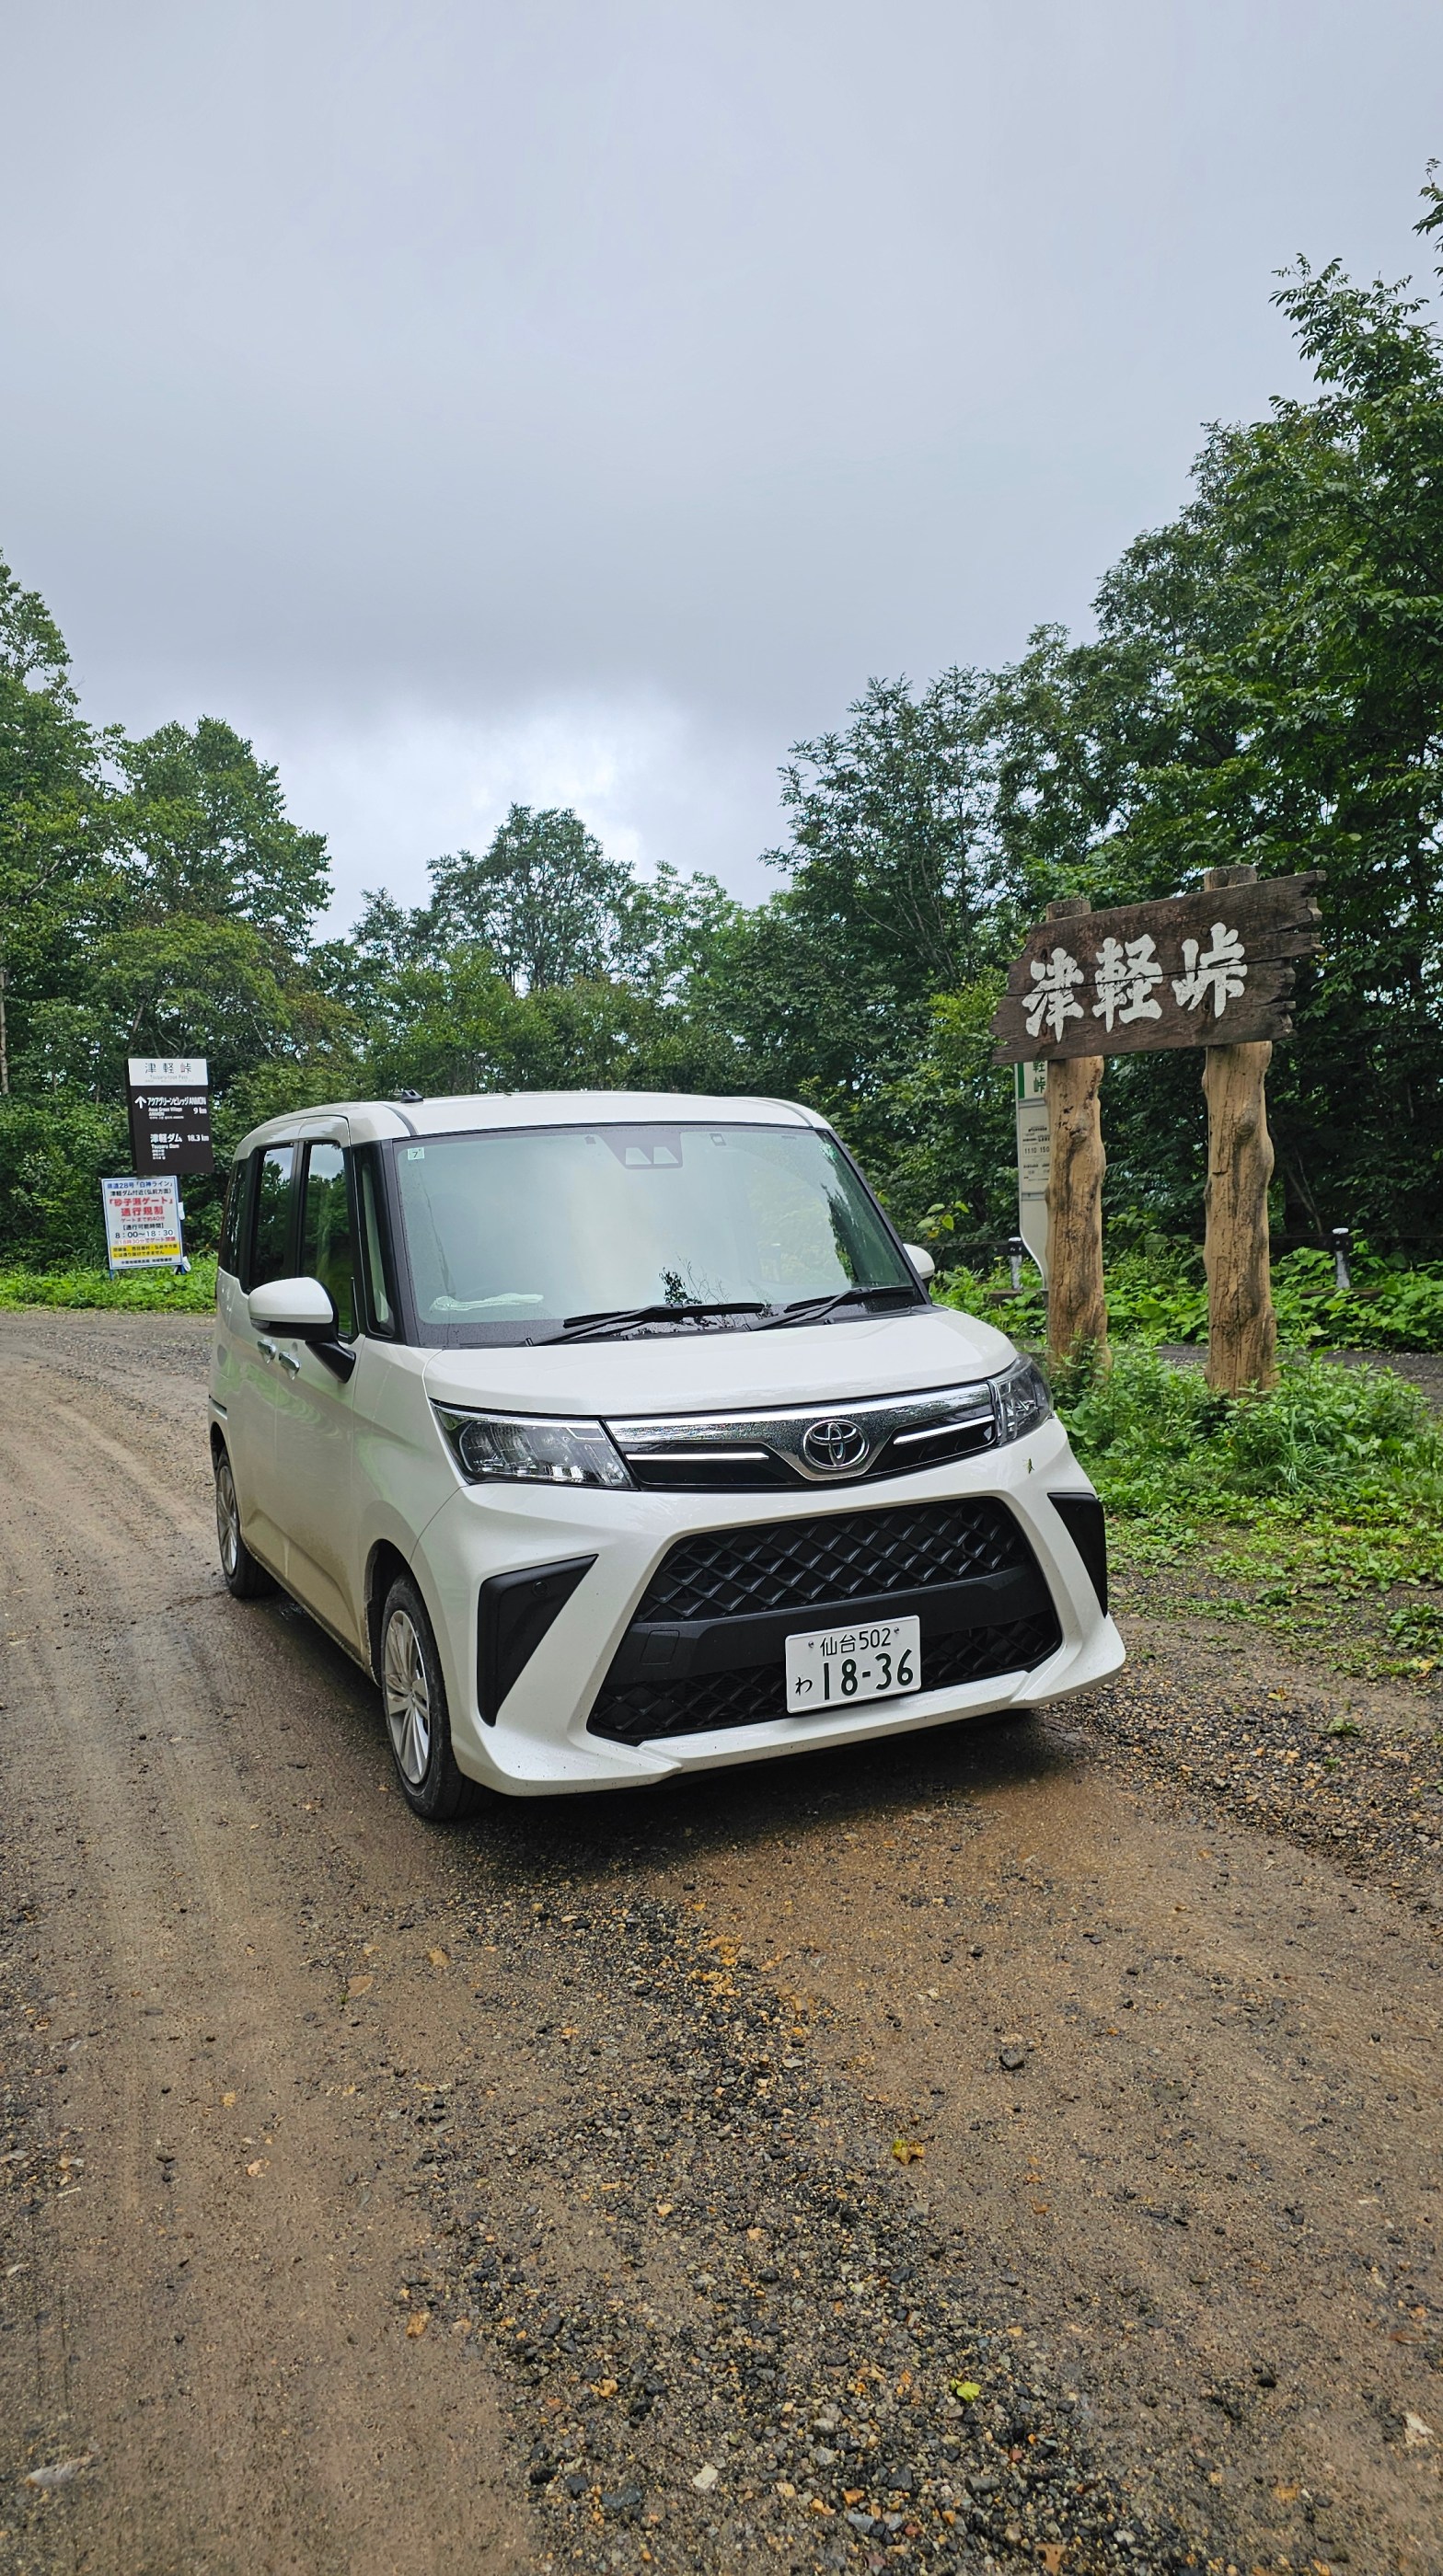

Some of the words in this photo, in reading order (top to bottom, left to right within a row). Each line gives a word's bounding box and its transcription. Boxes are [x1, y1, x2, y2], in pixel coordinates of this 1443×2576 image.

[1022, 922, 1248, 1043] 津軽峠
[144, 1062, 192, 1074] 津軽峠
[150, 1133, 182, 1143] 津軽ダム
[121, 1206, 164, 1216] 通行規制
[795, 1676, 813, 1696] わ
[823, 1649, 914, 1700] 18-36
